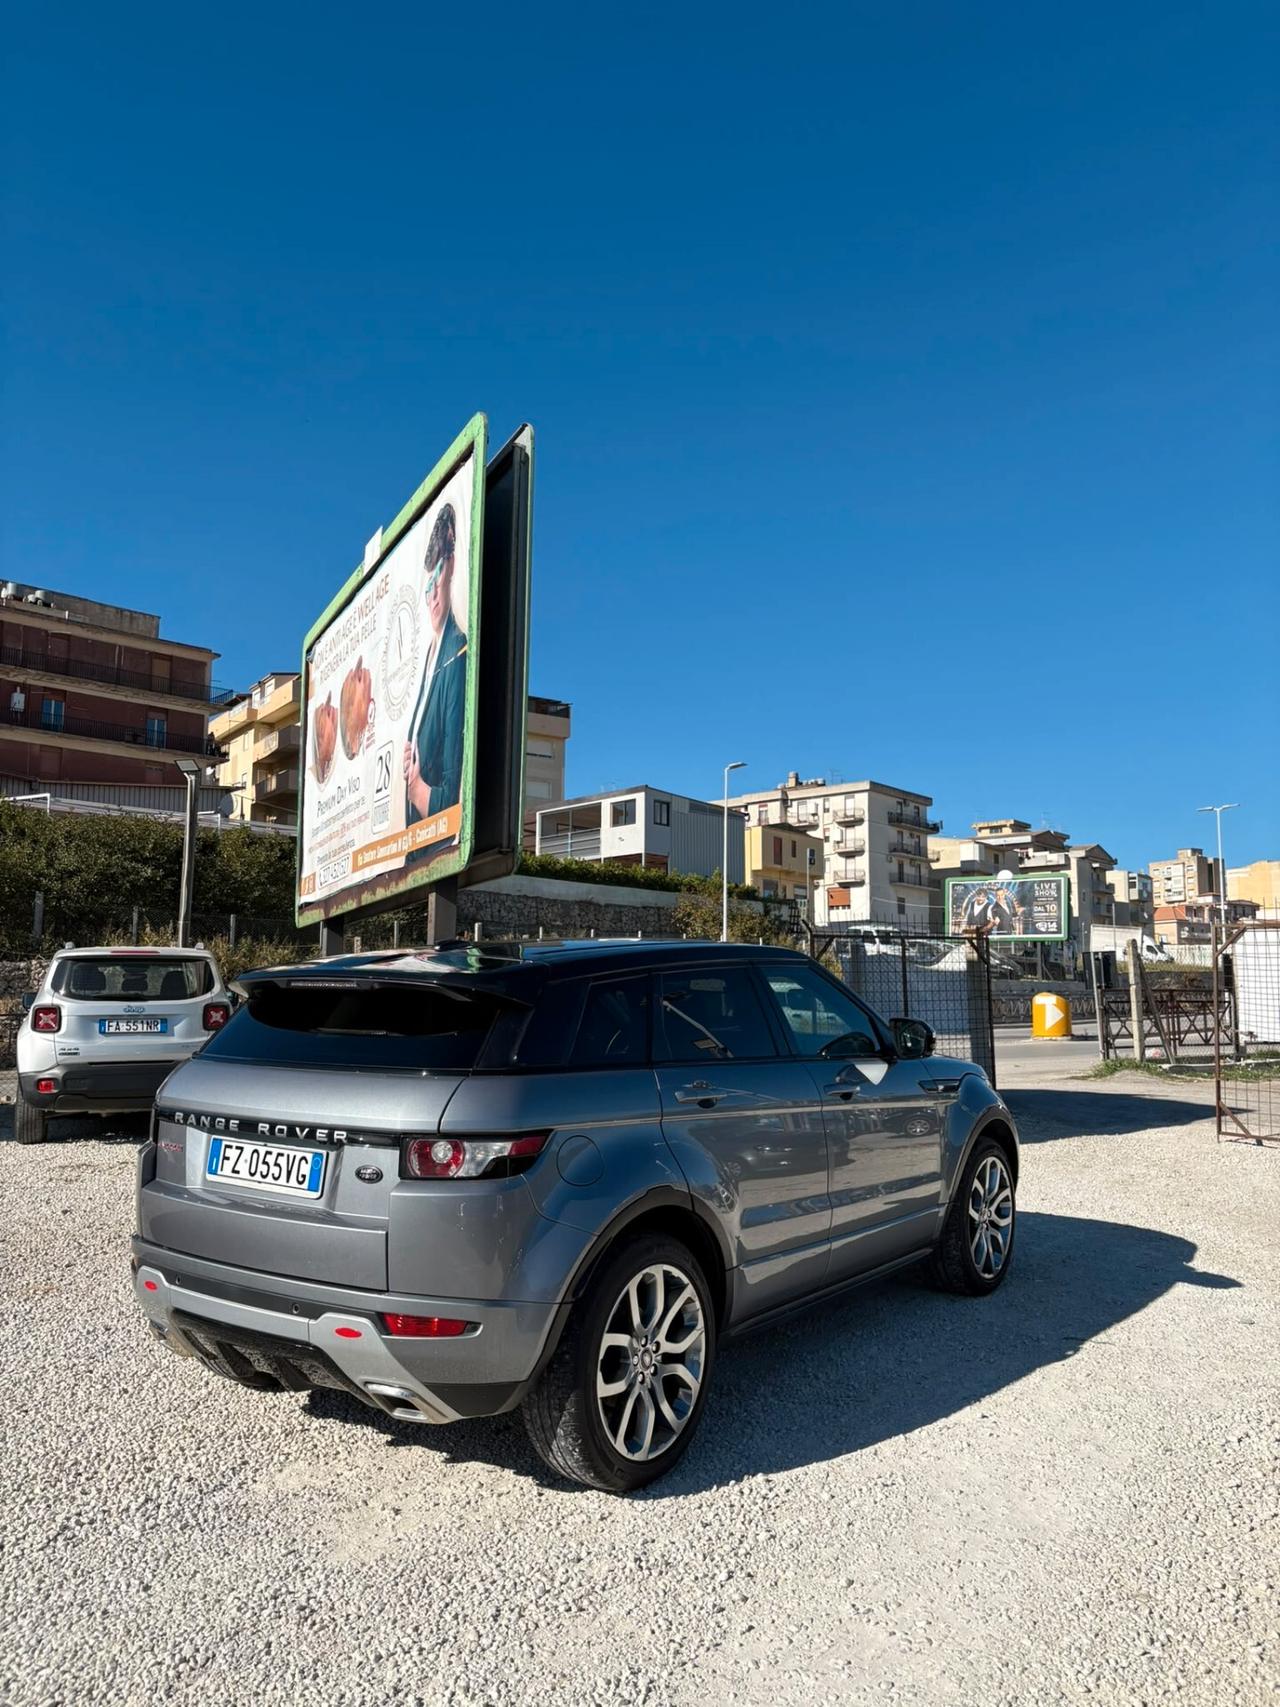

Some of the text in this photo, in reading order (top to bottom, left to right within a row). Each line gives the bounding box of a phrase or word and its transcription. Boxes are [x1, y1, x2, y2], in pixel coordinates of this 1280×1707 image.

[375, 751, 391, 794] 28
[1034, 882, 1057, 890] LIVE
[1034, 890, 1058, 898] SHOW
[1045, 904, 1057, 912] 10
[107, 1020, 160, 1032] FA 551NR
[174, 1111, 349, 1143] RANGE ROVER
[219, 1144, 309, 1185] FZ 055VG
